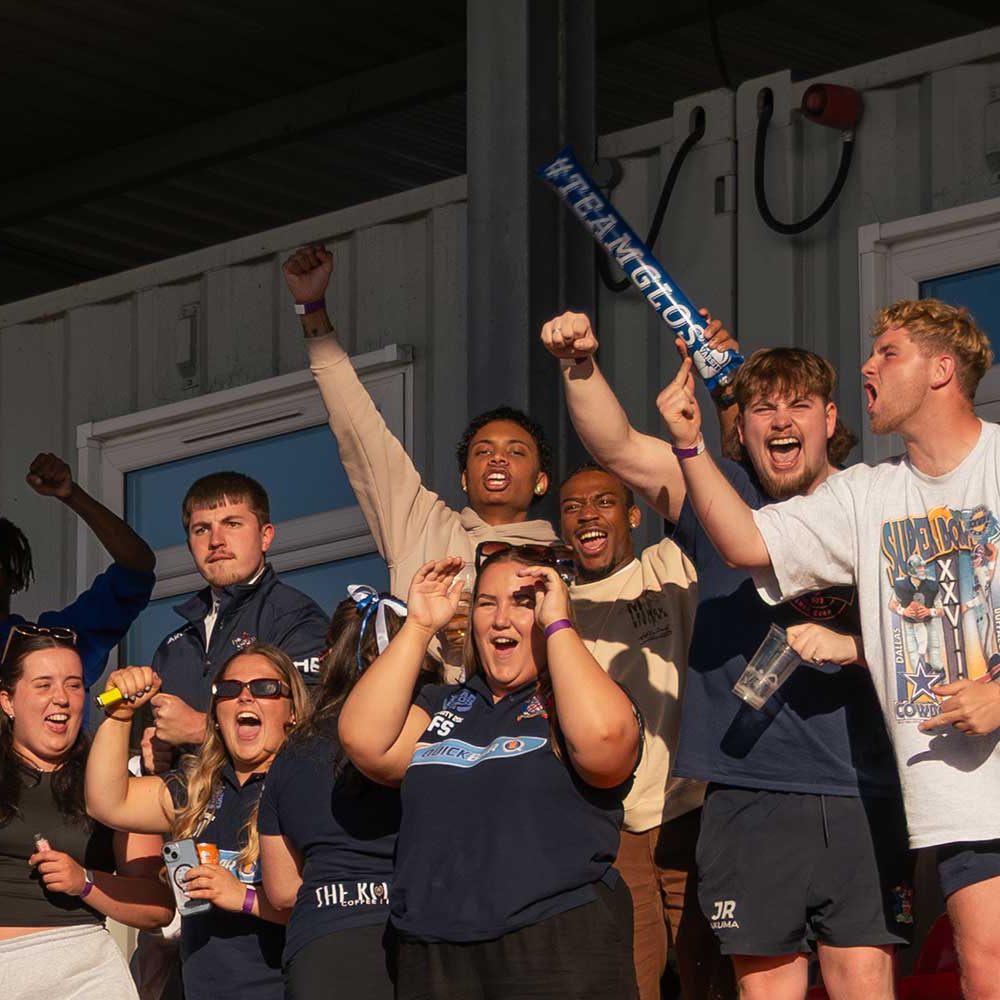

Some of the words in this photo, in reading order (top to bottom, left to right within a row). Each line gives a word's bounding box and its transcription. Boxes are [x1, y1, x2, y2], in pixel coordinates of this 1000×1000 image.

[895, 628, 905, 665] DALLAS
[896, 703, 943, 719] COWB
[427, 715, 455, 737] FS
[711, 900, 736, 920] JR
